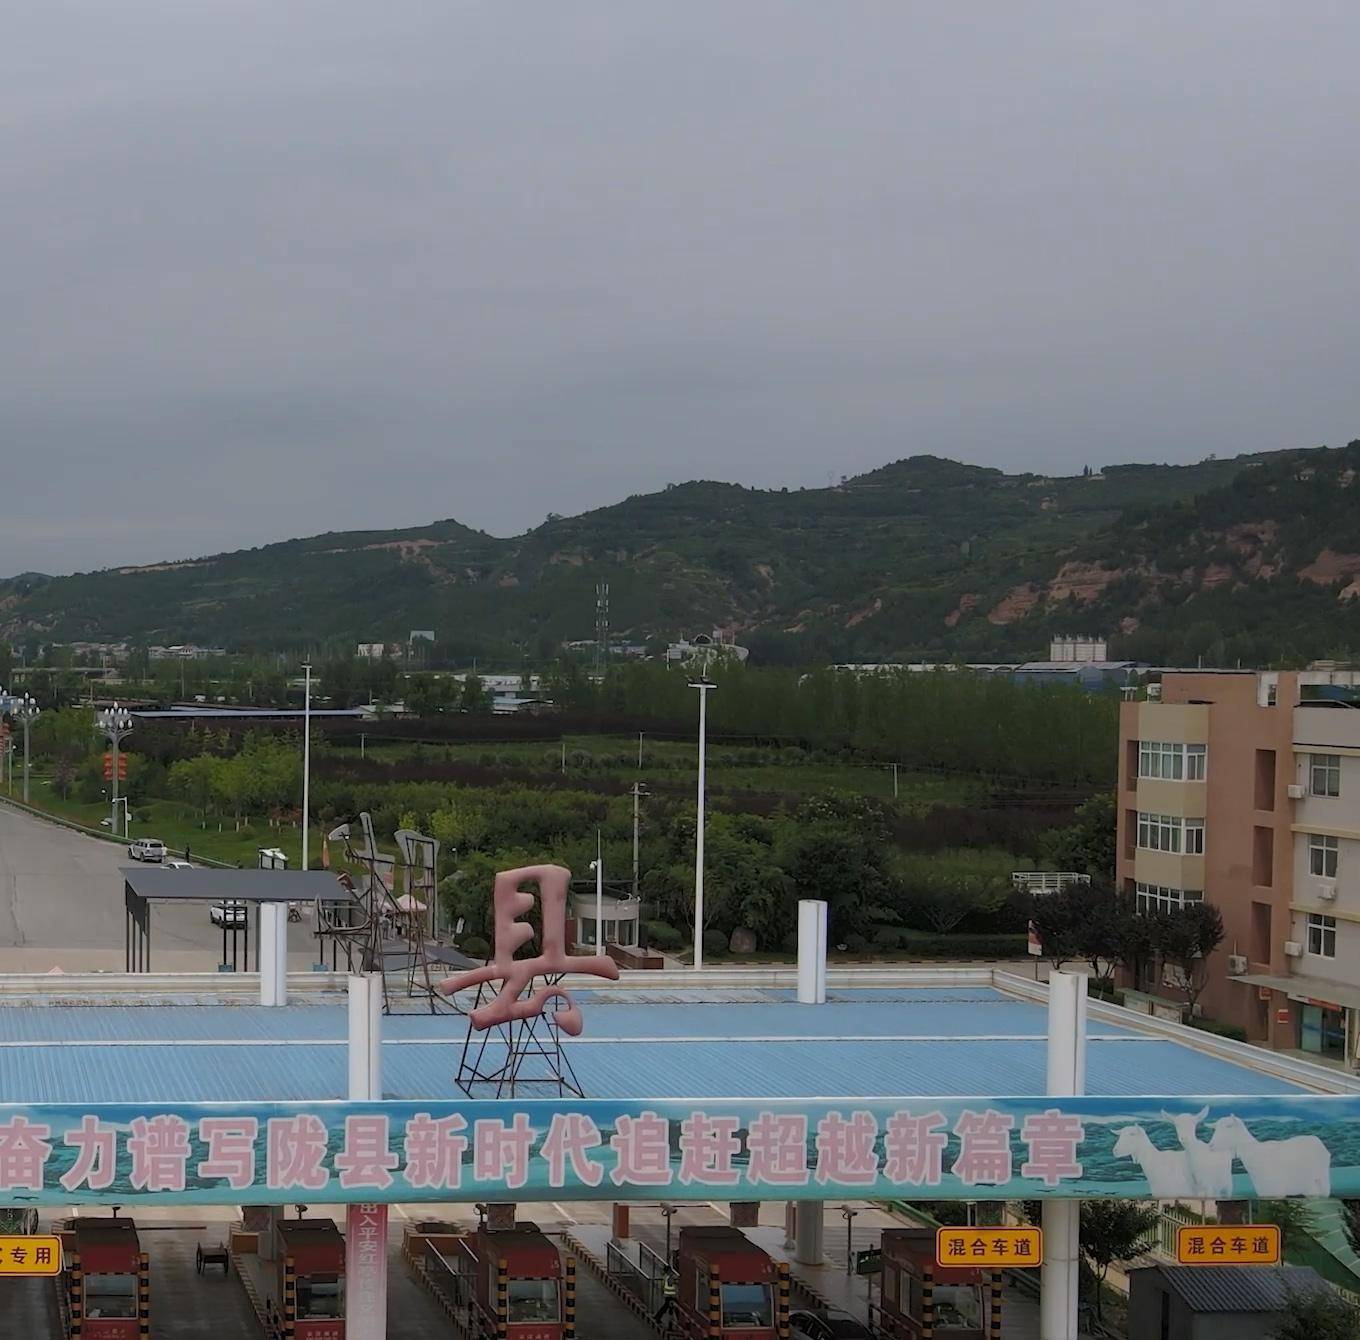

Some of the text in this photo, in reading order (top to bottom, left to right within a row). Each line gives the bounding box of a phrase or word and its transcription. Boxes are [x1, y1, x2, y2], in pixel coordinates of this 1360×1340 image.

[948, 1238, 1032, 1256] 混合车道
[1187, 1236, 1269, 1255] 混合车道
[10, 1246, 51, 1264] 专用
